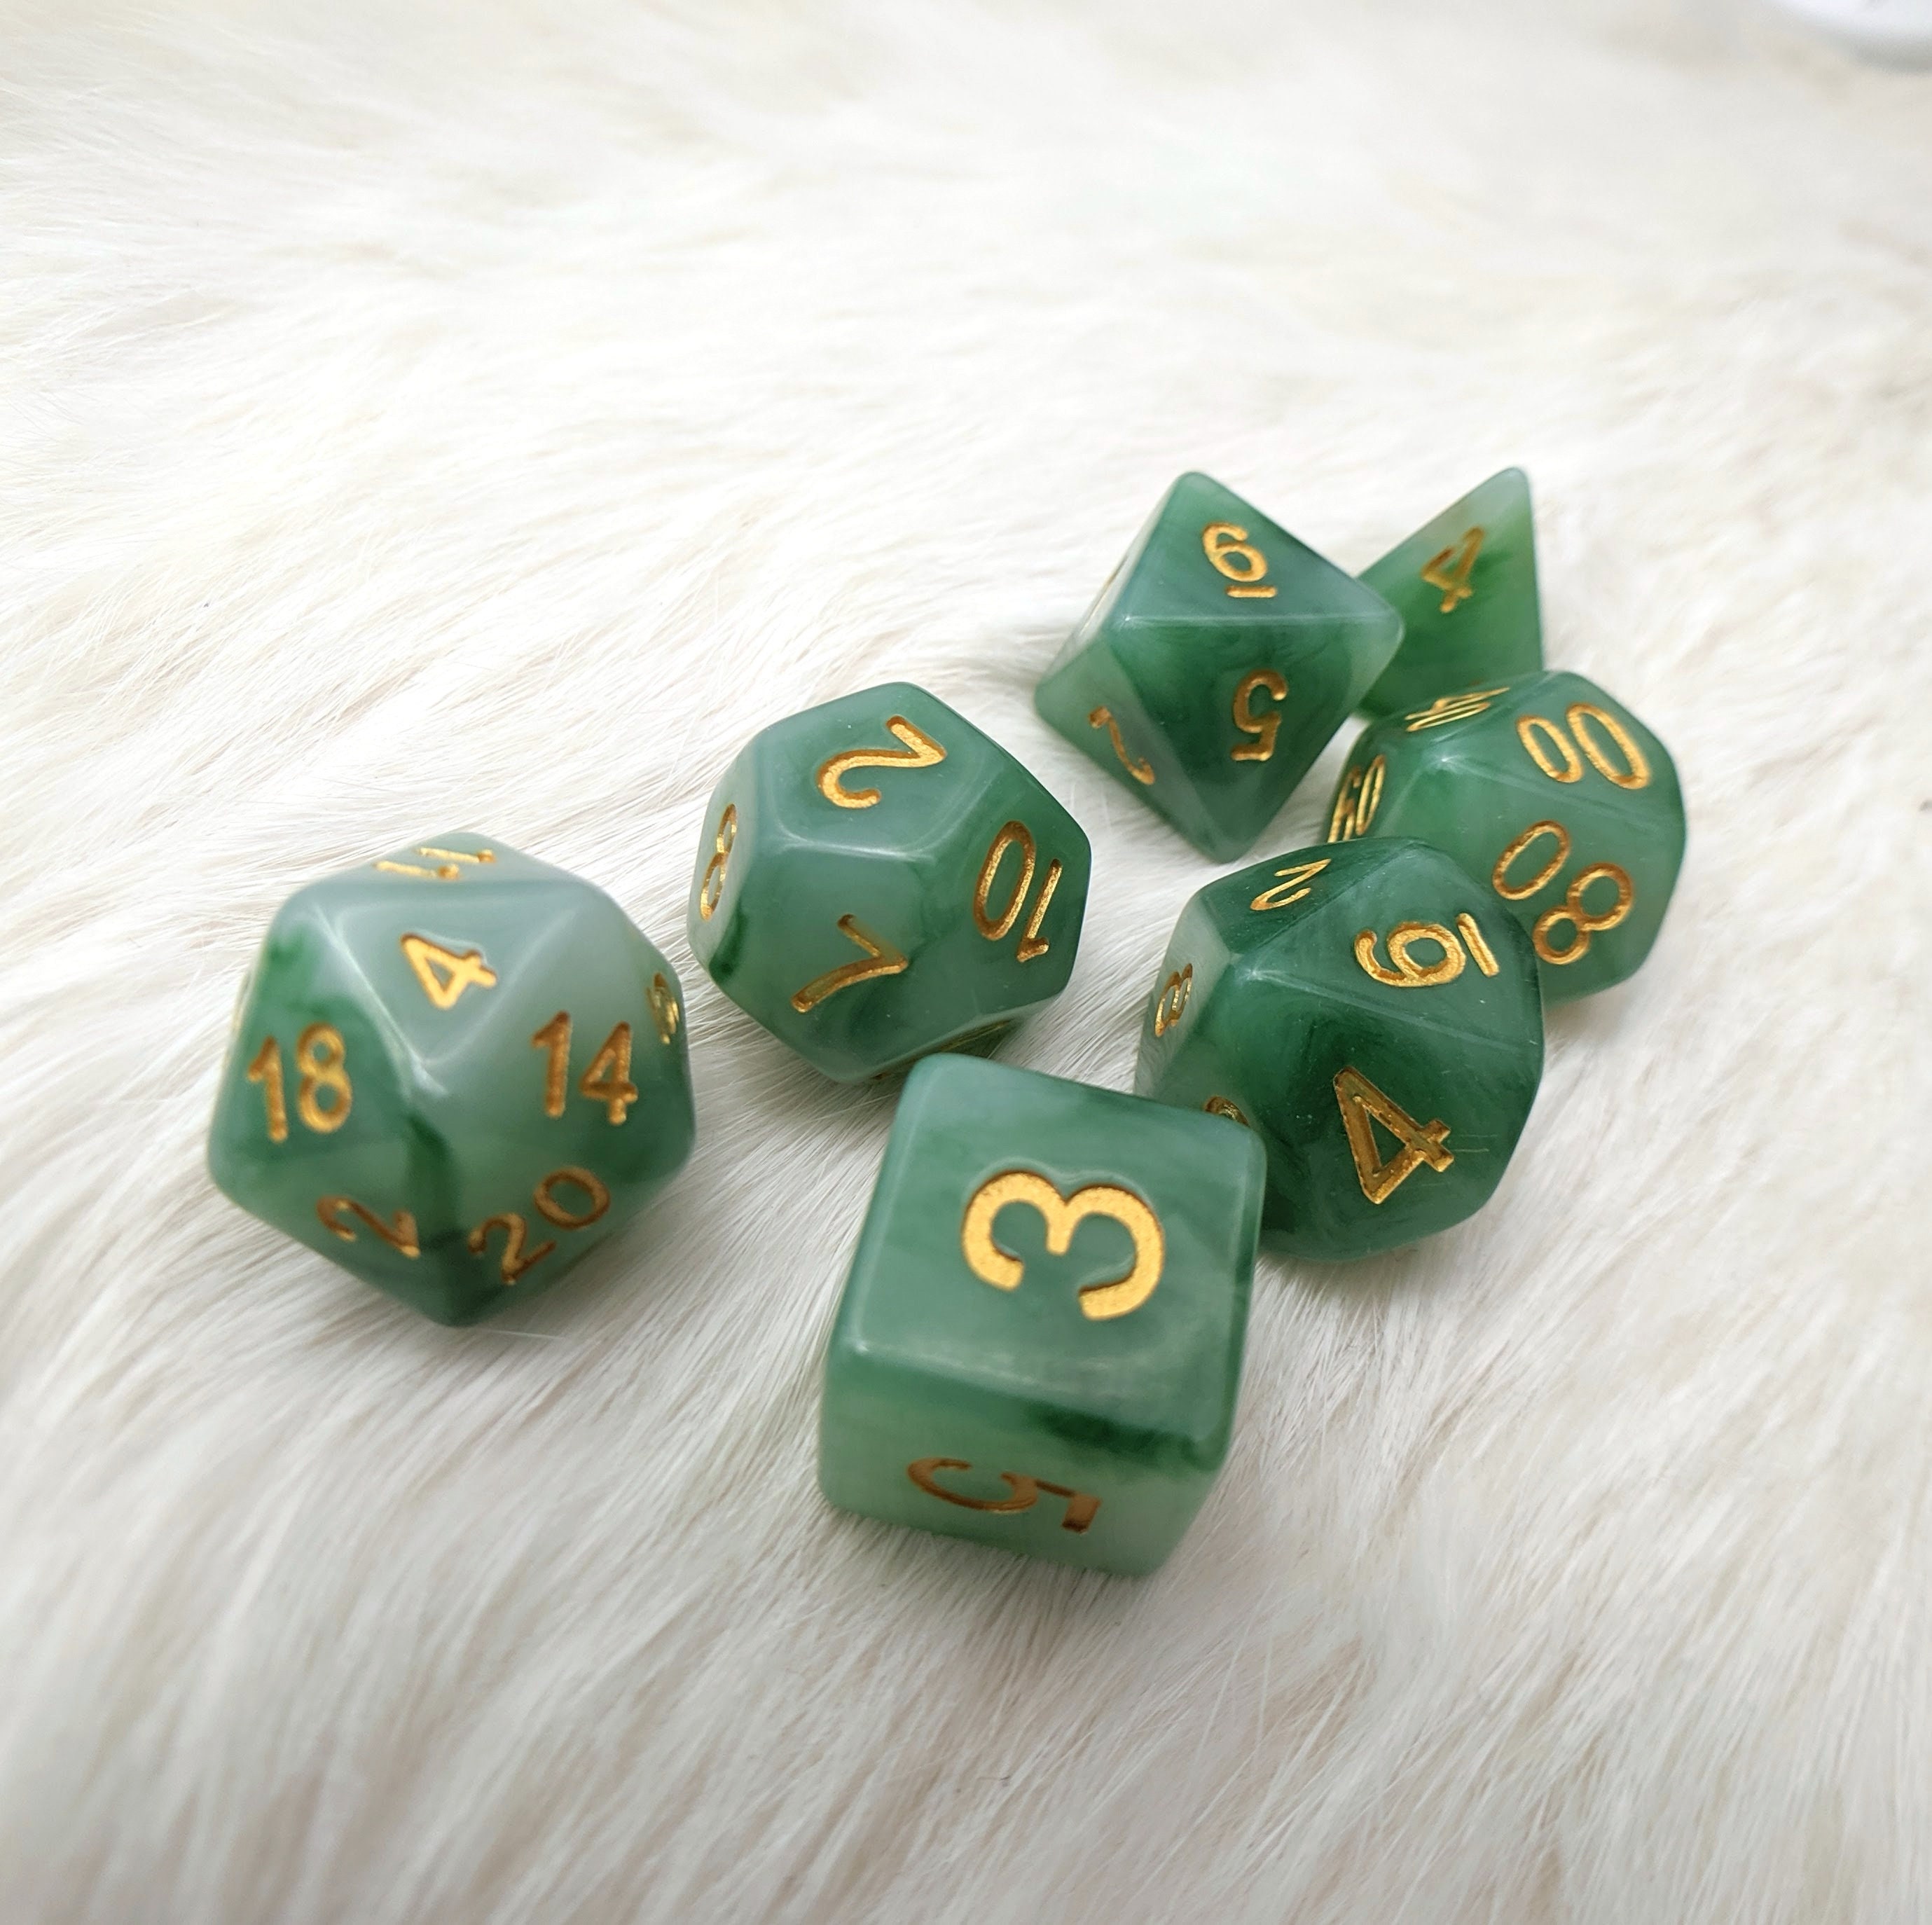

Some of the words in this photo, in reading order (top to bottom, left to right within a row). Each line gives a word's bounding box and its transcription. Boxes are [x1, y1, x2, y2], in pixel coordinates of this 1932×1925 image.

[1203, 522, 1276, 598] 6
[1422, 526, 1484, 613] 4
[1231, 669, 1288, 761] 5
[1517, 703, 1649, 789] 00
[817, 715, 946, 808] 2
[701, 803, 736, 920] 8
[973, 820, 1062, 962] 10
[1250, 859, 1331, 911] 2
[1492, 820, 1634, 966] 80
[401, 933, 496, 1009] 4
[791, 914, 909, 1014] 7
[1355, 913, 1500, 988] 6
[1154, 963, 1193, 1037] 8
[247, 1022, 352, 1142] 18
[531, 1011, 638, 1126] 14
[1334, 1066, 1455, 1205] 4
[315, 1196, 421, 1259] 2
[467, 1166, 612, 1285] 20
[960, 1169, 1165, 1321] 3
[906, 1456, 1103, 1534] 5
